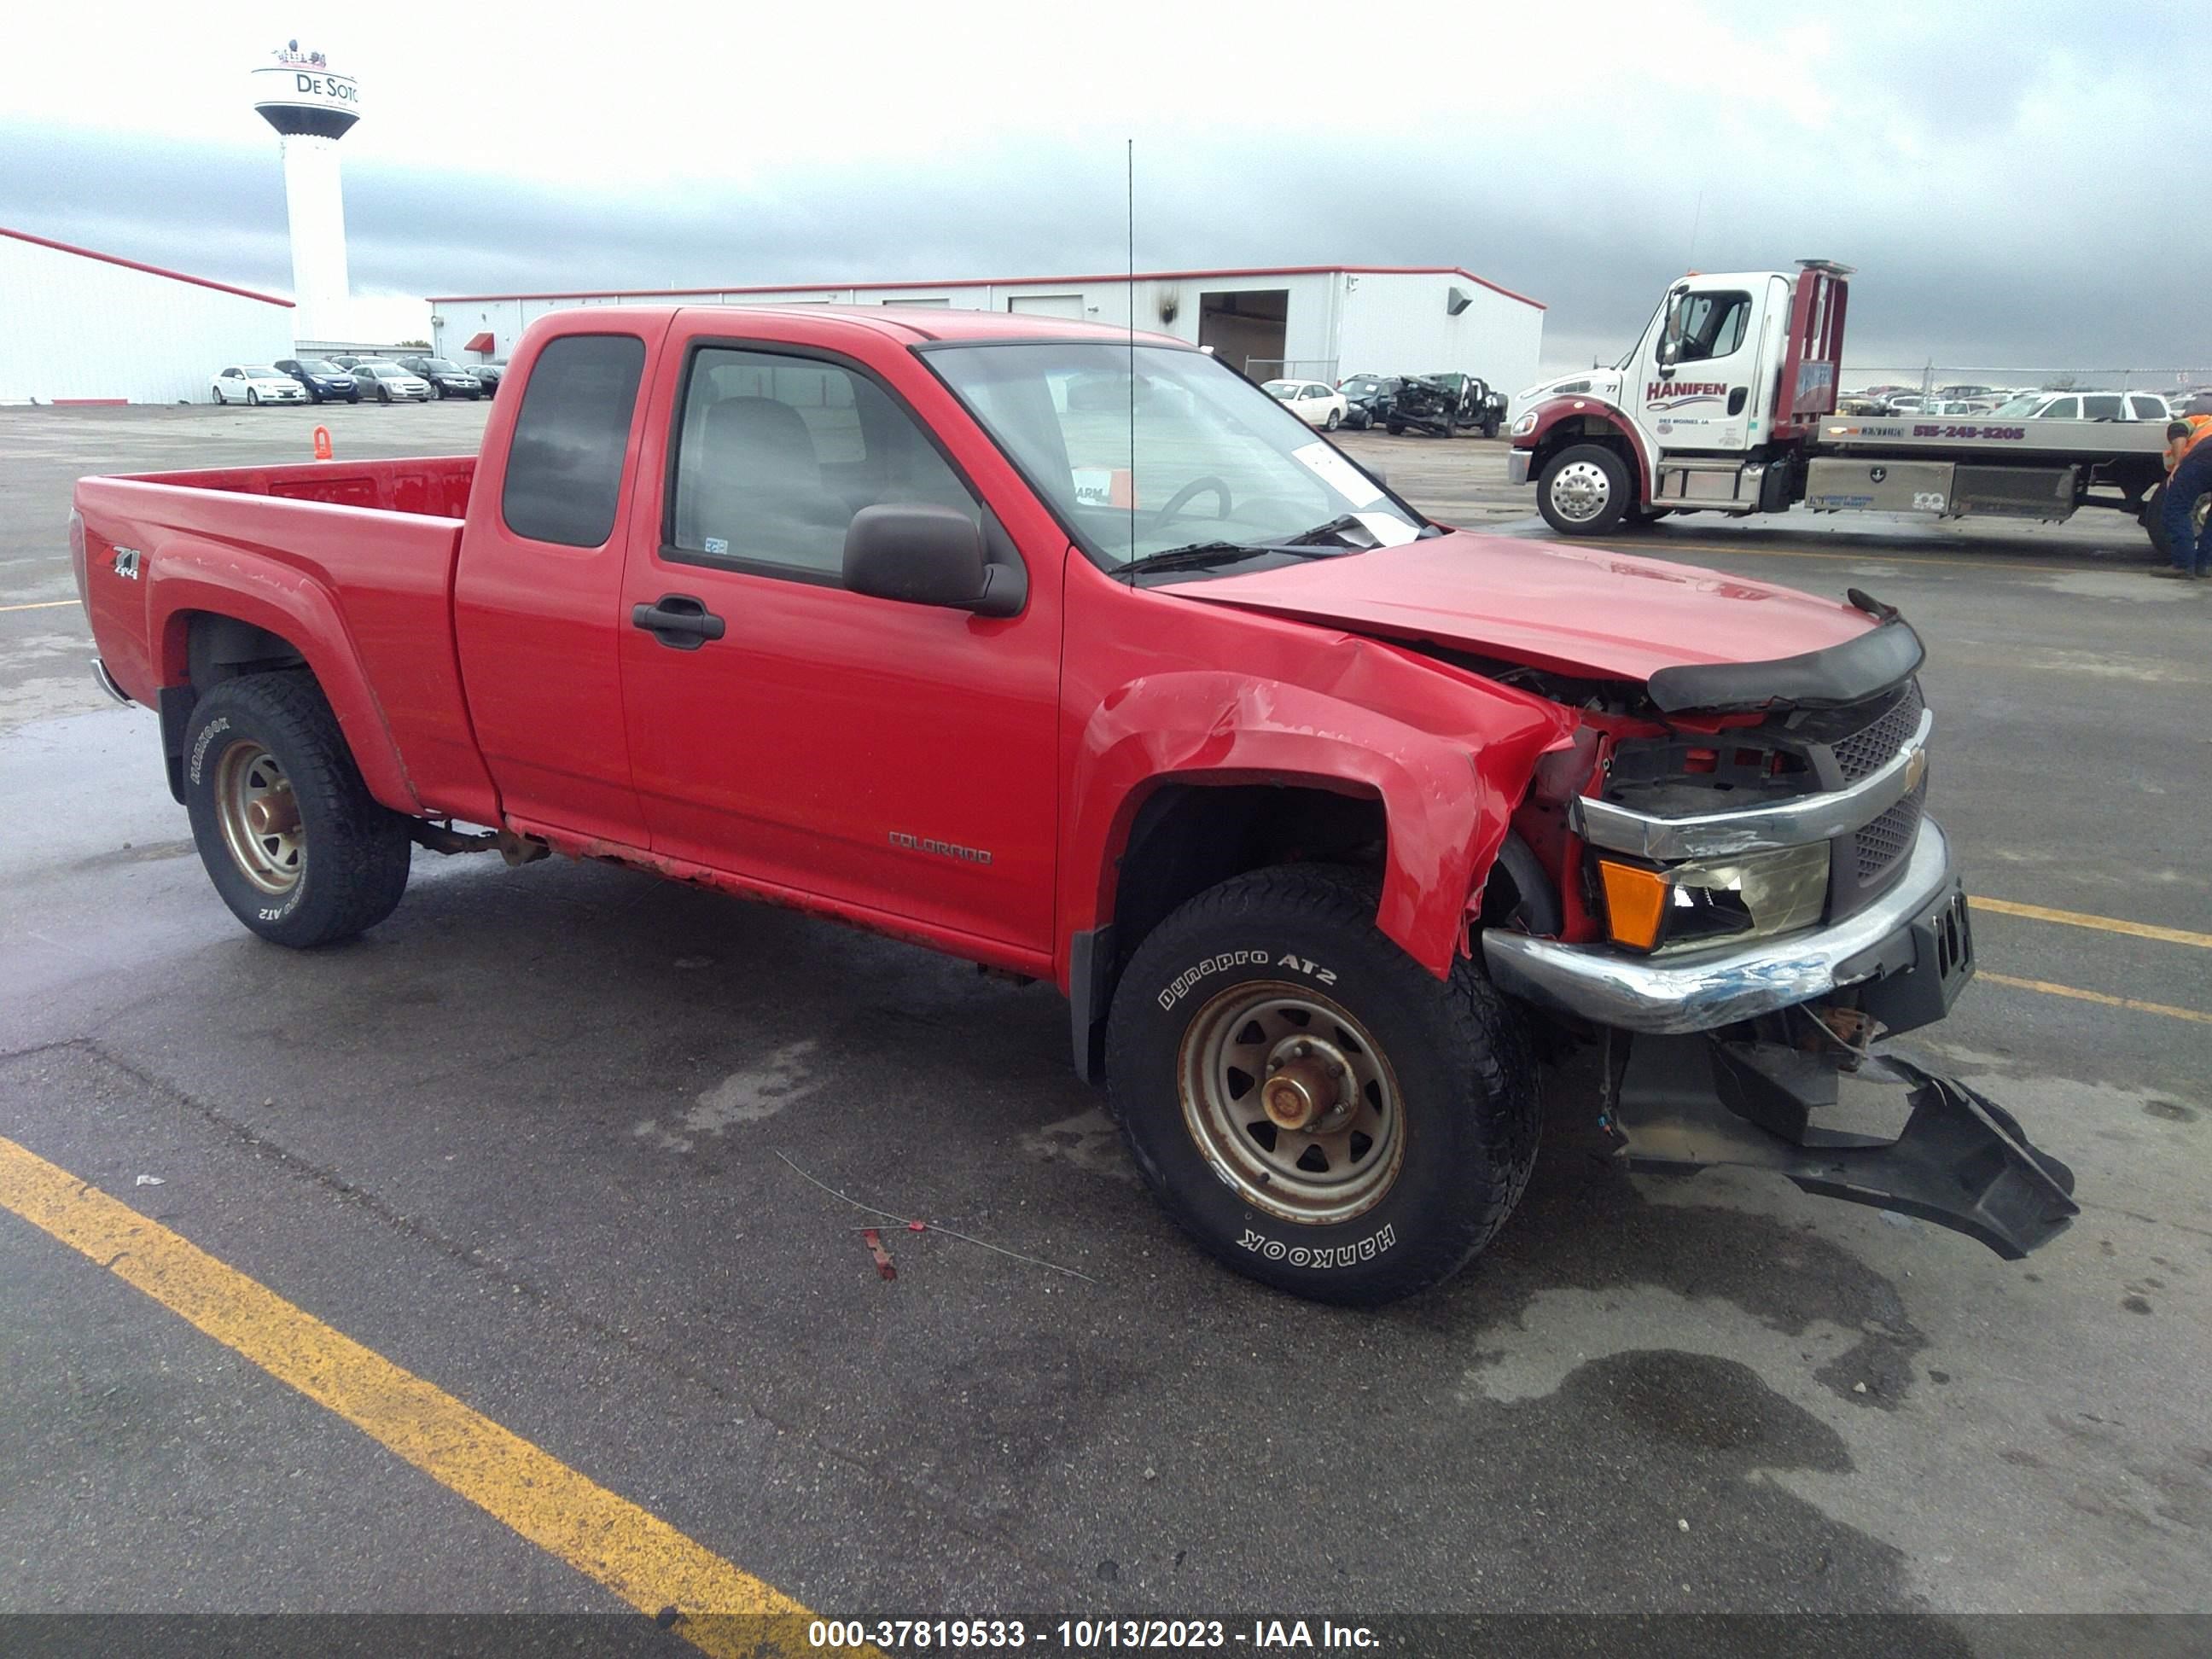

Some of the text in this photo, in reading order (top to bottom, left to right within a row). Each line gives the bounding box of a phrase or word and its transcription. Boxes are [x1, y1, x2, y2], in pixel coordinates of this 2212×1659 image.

[1646, 382, 1727, 401] HANIFEN
[888, 831, 992, 864] COLORADO
[259, 908, 282, 921] AT2
[1157, 951, 1337, 1010] Dynapro AT2
